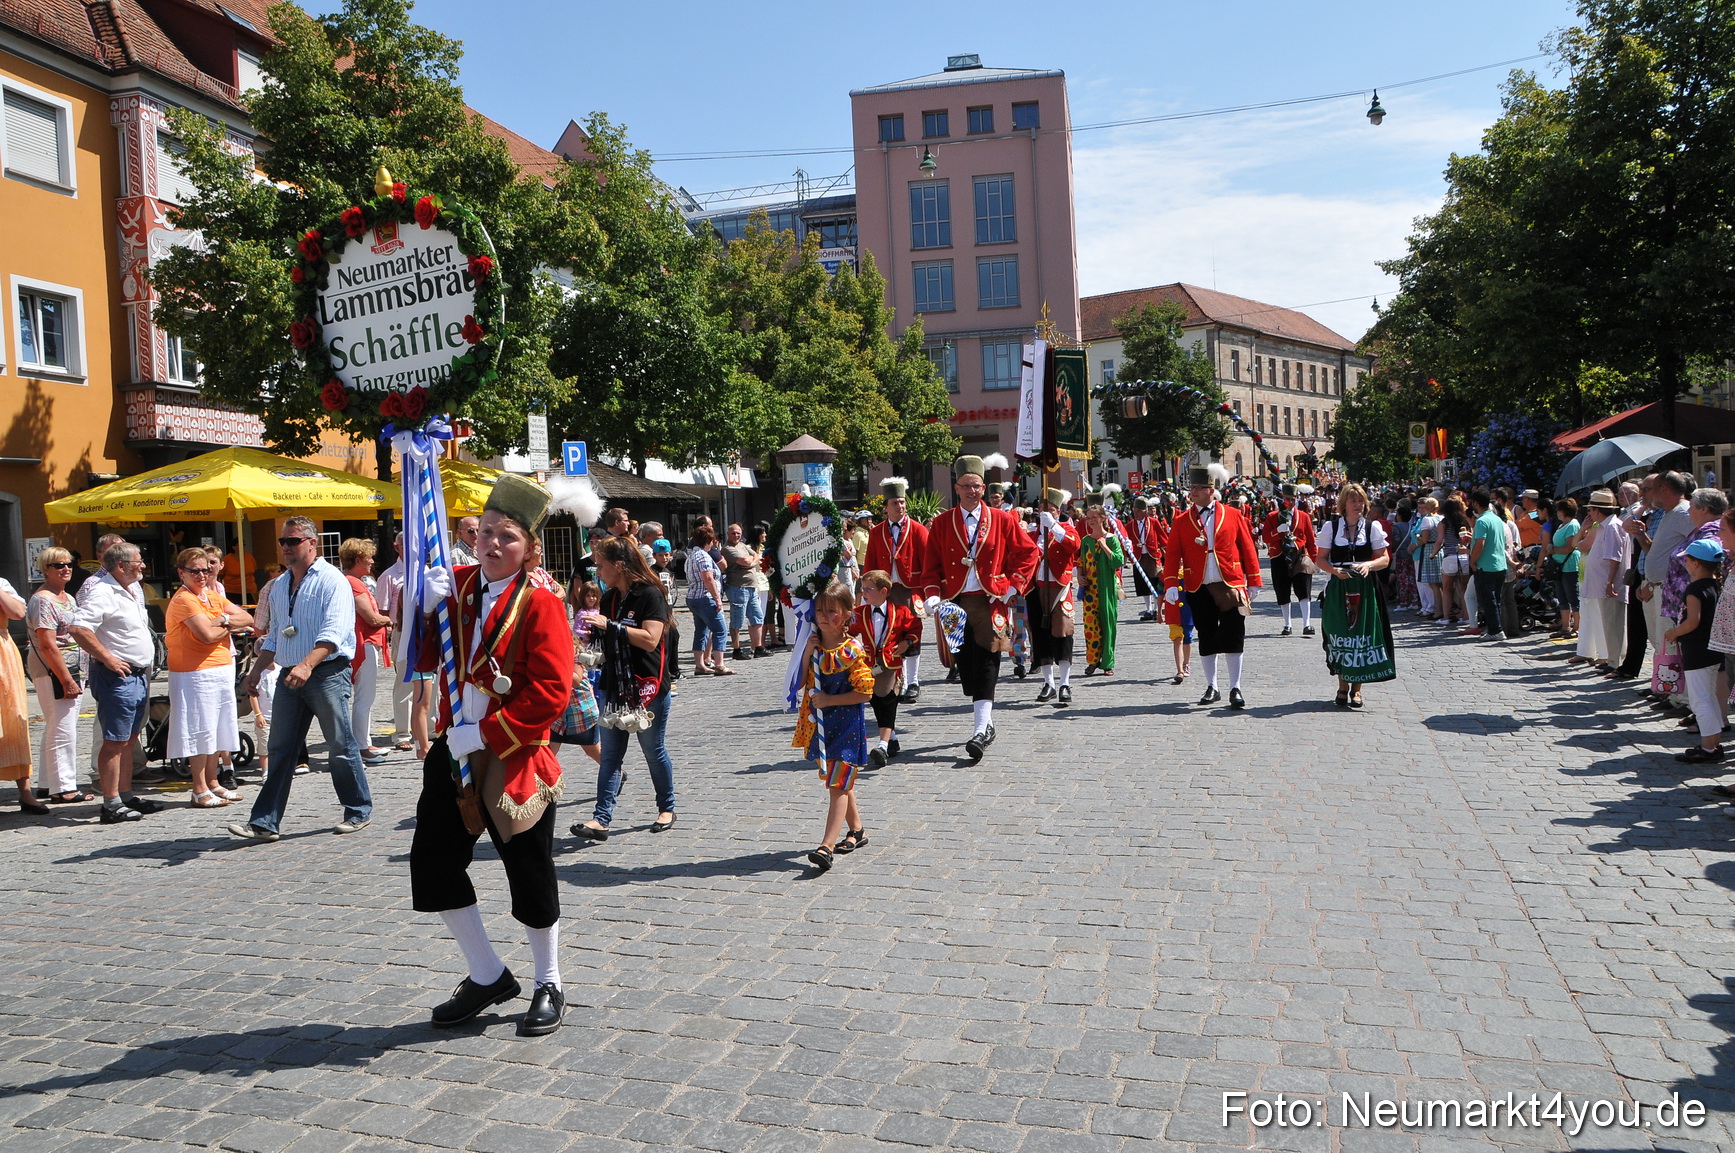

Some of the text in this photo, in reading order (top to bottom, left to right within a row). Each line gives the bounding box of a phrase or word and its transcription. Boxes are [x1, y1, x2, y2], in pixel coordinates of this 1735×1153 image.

[337, 244, 454, 289] Neumarkter
[318, 264, 477, 325] Lammsbräu
[329, 312, 465, 372] Schäffle
[352, 363, 452, 393] Tanzgrupp
[568, 446, 581, 471] P
[110, 500, 125, 510] Café
[133, 497, 166, 508] Konditorei
[308, 492, 323, 500] Café
[331, 492, 363, 501] Konditorei
[787, 531, 825, 556] Lammsbräu
[791, 525, 819, 544] Neumarkter
[1378, 668, 1394, 677] BIER
